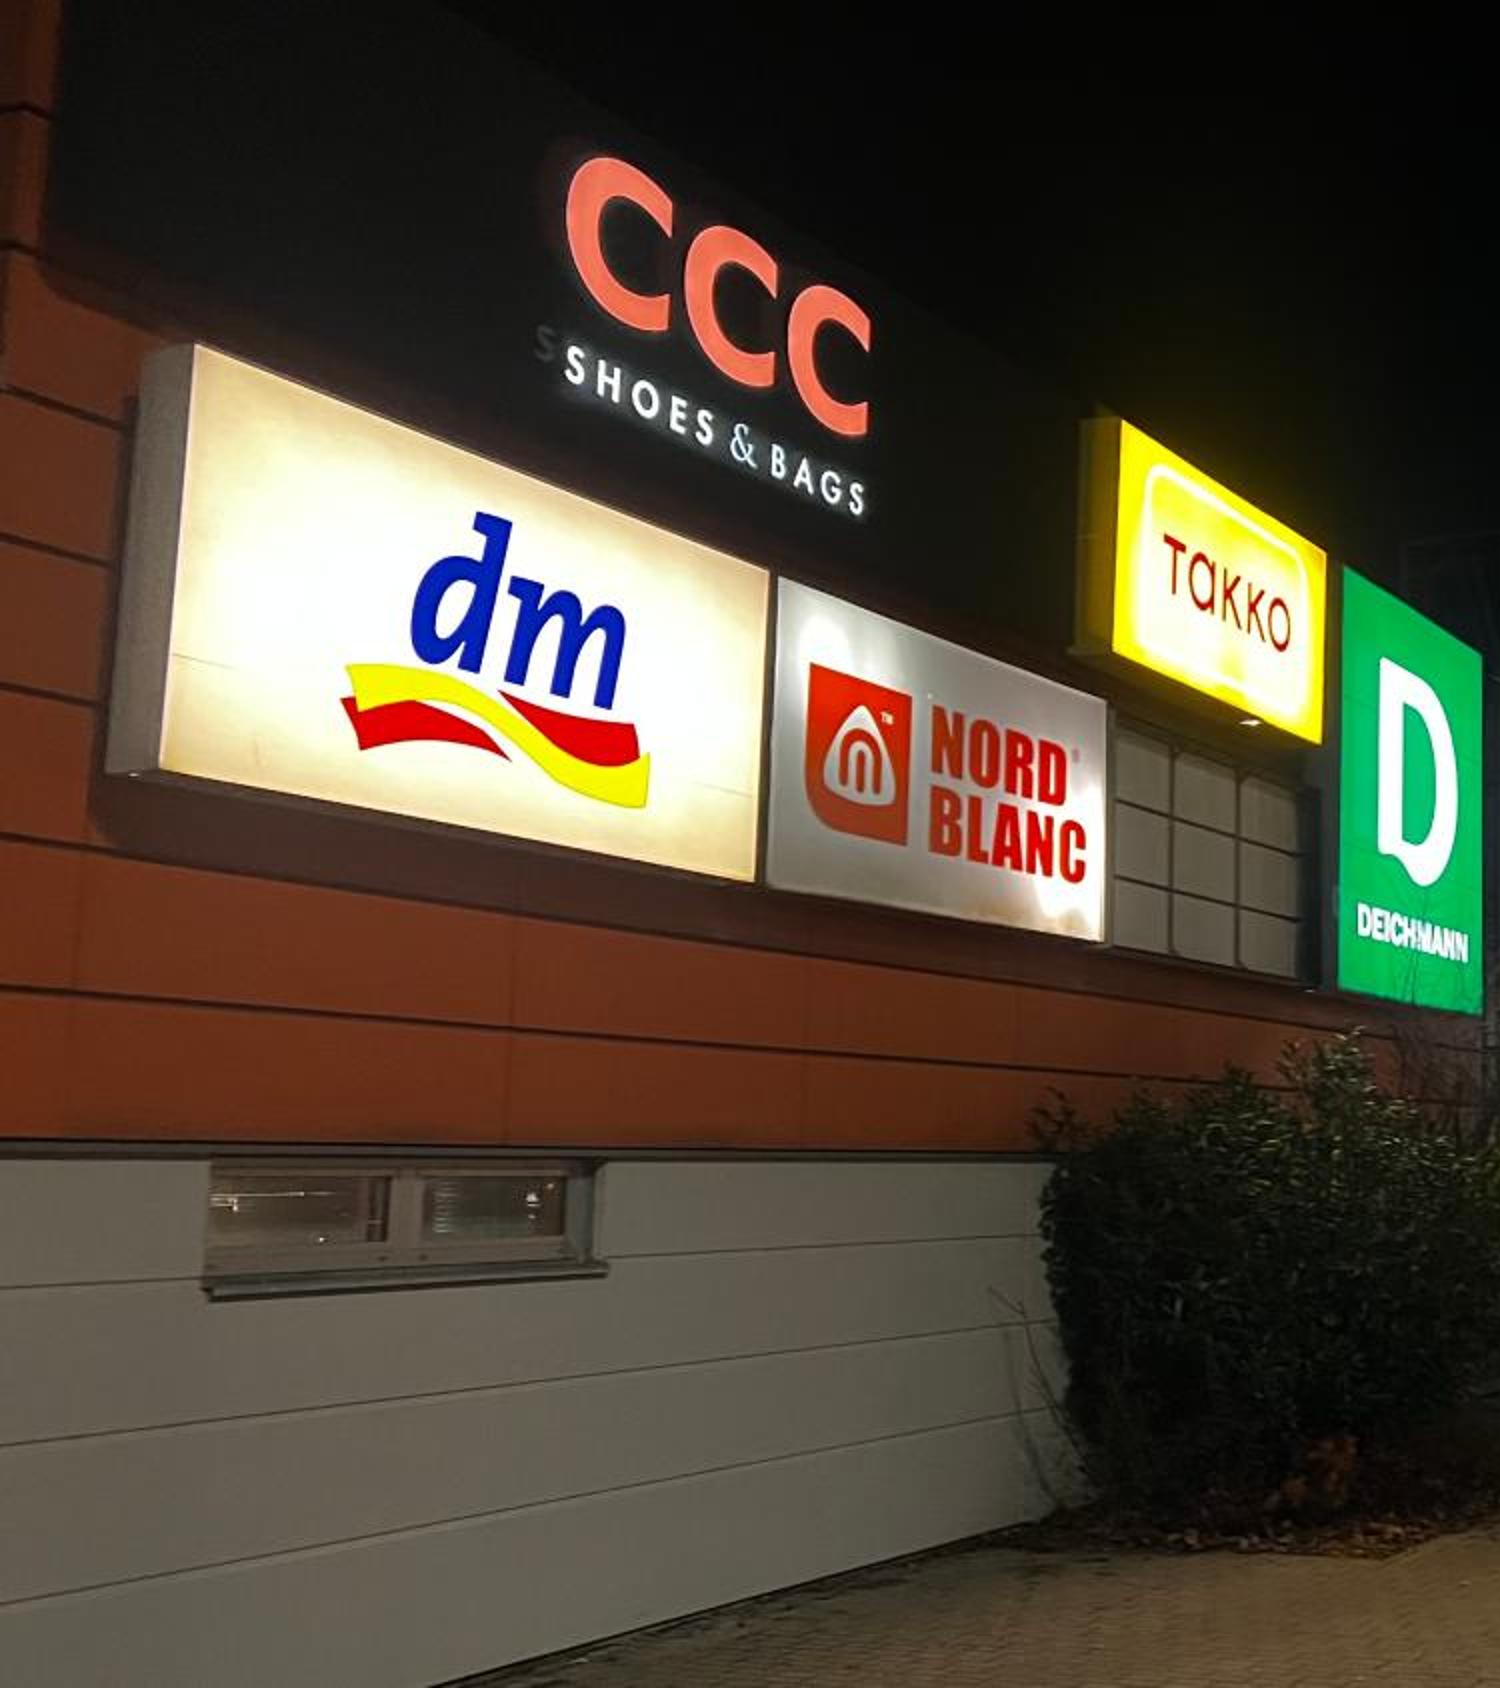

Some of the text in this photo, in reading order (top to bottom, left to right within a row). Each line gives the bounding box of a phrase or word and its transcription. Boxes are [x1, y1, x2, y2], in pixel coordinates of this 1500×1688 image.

[565, 157, 873, 436] CCC
[564, 345, 865, 515] SHOES & BAGS
[410, 511, 626, 710] dm
[928, 784, 1086, 884] BLANC
[931, 704, 1068, 807] NORD
[1378, 656, 1458, 887] D
[1357, 901, 1468, 964] DEICHMANN
